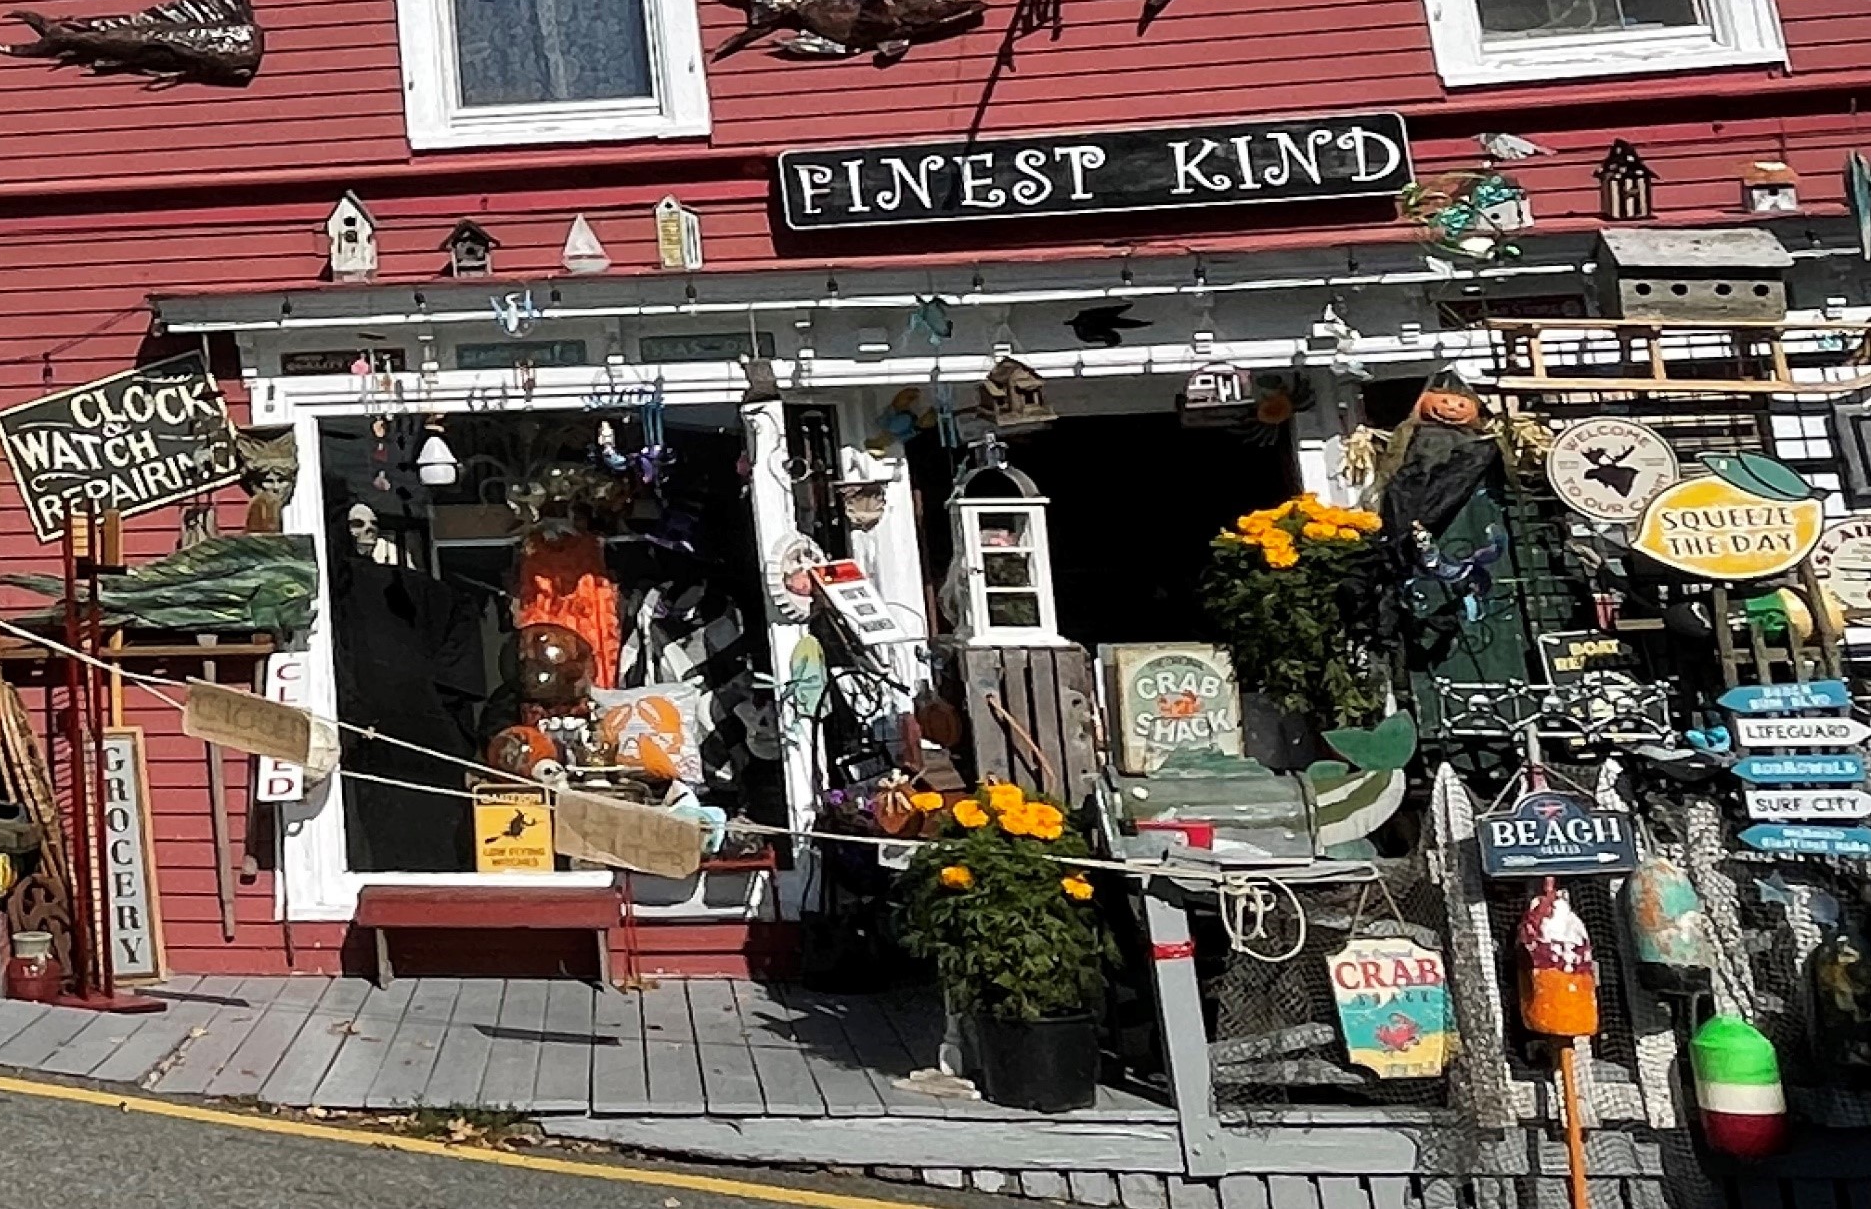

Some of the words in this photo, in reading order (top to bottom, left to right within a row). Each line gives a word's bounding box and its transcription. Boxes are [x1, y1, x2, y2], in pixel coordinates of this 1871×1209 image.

[792, 145, 1107, 215] FINEST
[1169, 126, 1402, 194] KIND
[70, 383, 220, 429] CLOCK
[8, 430, 160, 473] WATCH
[1562, 424, 1652, 451] WELCOME
[1661, 506, 1793, 531] SQUEEZE
[1668, 536, 1720, 556] THE
[1730, 532, 1792, 553] DAY
[1136, 671, 1220, 700] CRAB
[1135, 708, 1232, 743] SHACK
[1745, 723, 1850, 739] LIFEGUARD
[1755, 798, 1802, 811] SURF
[1812, 797, 1860, 811] CITY
[1490, 817, 1622, 848] BEACH
[104, 747, 142, 964] GROCERY
[1334, 958, 1442, 990] CRAB
